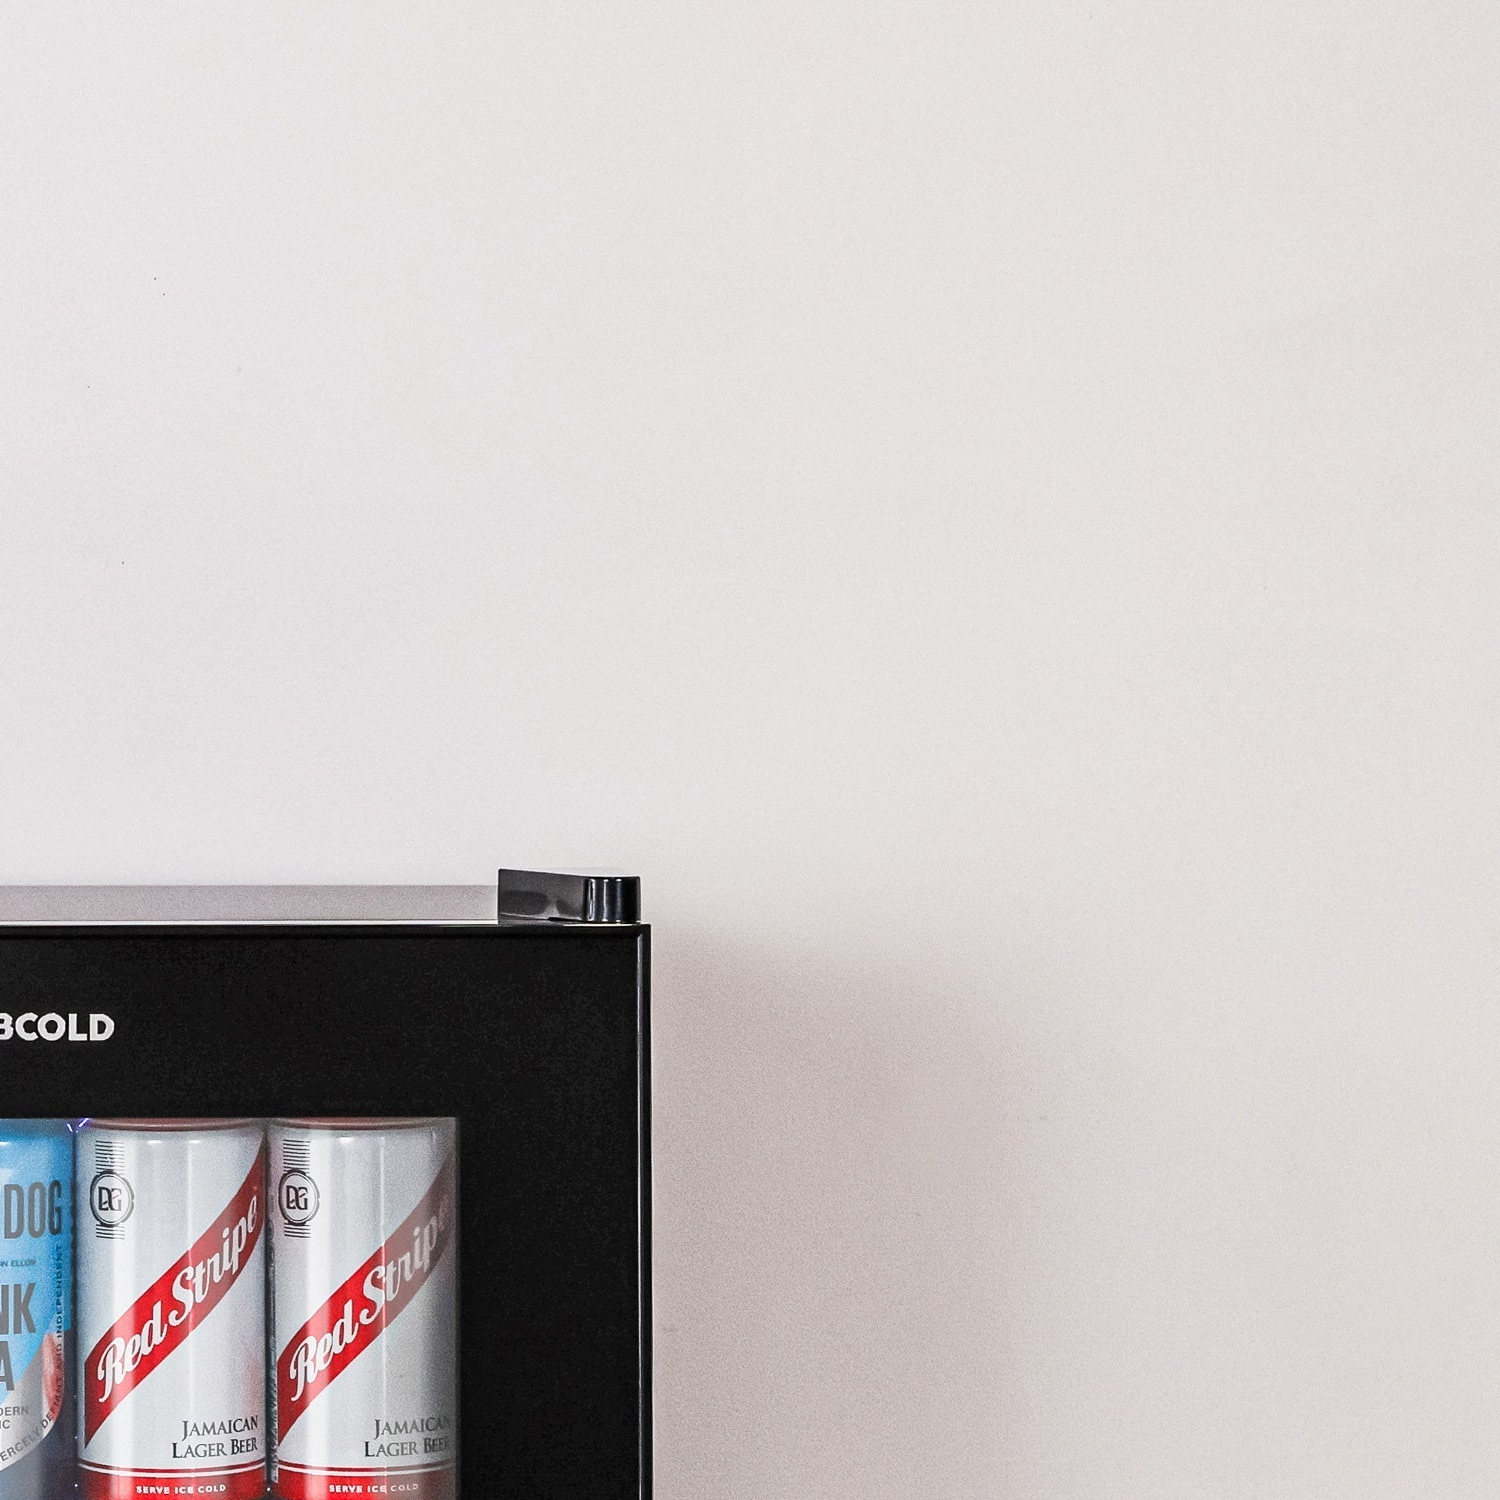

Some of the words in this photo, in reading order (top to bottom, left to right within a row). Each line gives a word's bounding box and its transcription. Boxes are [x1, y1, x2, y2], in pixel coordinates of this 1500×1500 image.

[97, 1301, 167, 1403] Red
[168, 1195, 258, 1326] Stripe
[289, 1299, 359, 1402] Red
[182, 1415, 259, 1442] JAMAICAN
[172, 1442, 227, 1459] LAGER
[231, 1437, 258, 1455] BEER
[364, 1441, 418, 1458] LAGER
[136, 1485, 170, 1494] SERVE
[174, 1485, 194, 1494] ICE
[197, 1484, 226, 1493] COLD
[329, 1484, 363, 1493] SERVE
[367, 1485, 387, 1493] ICE
[390, 1483, 419, 1492] COLD
